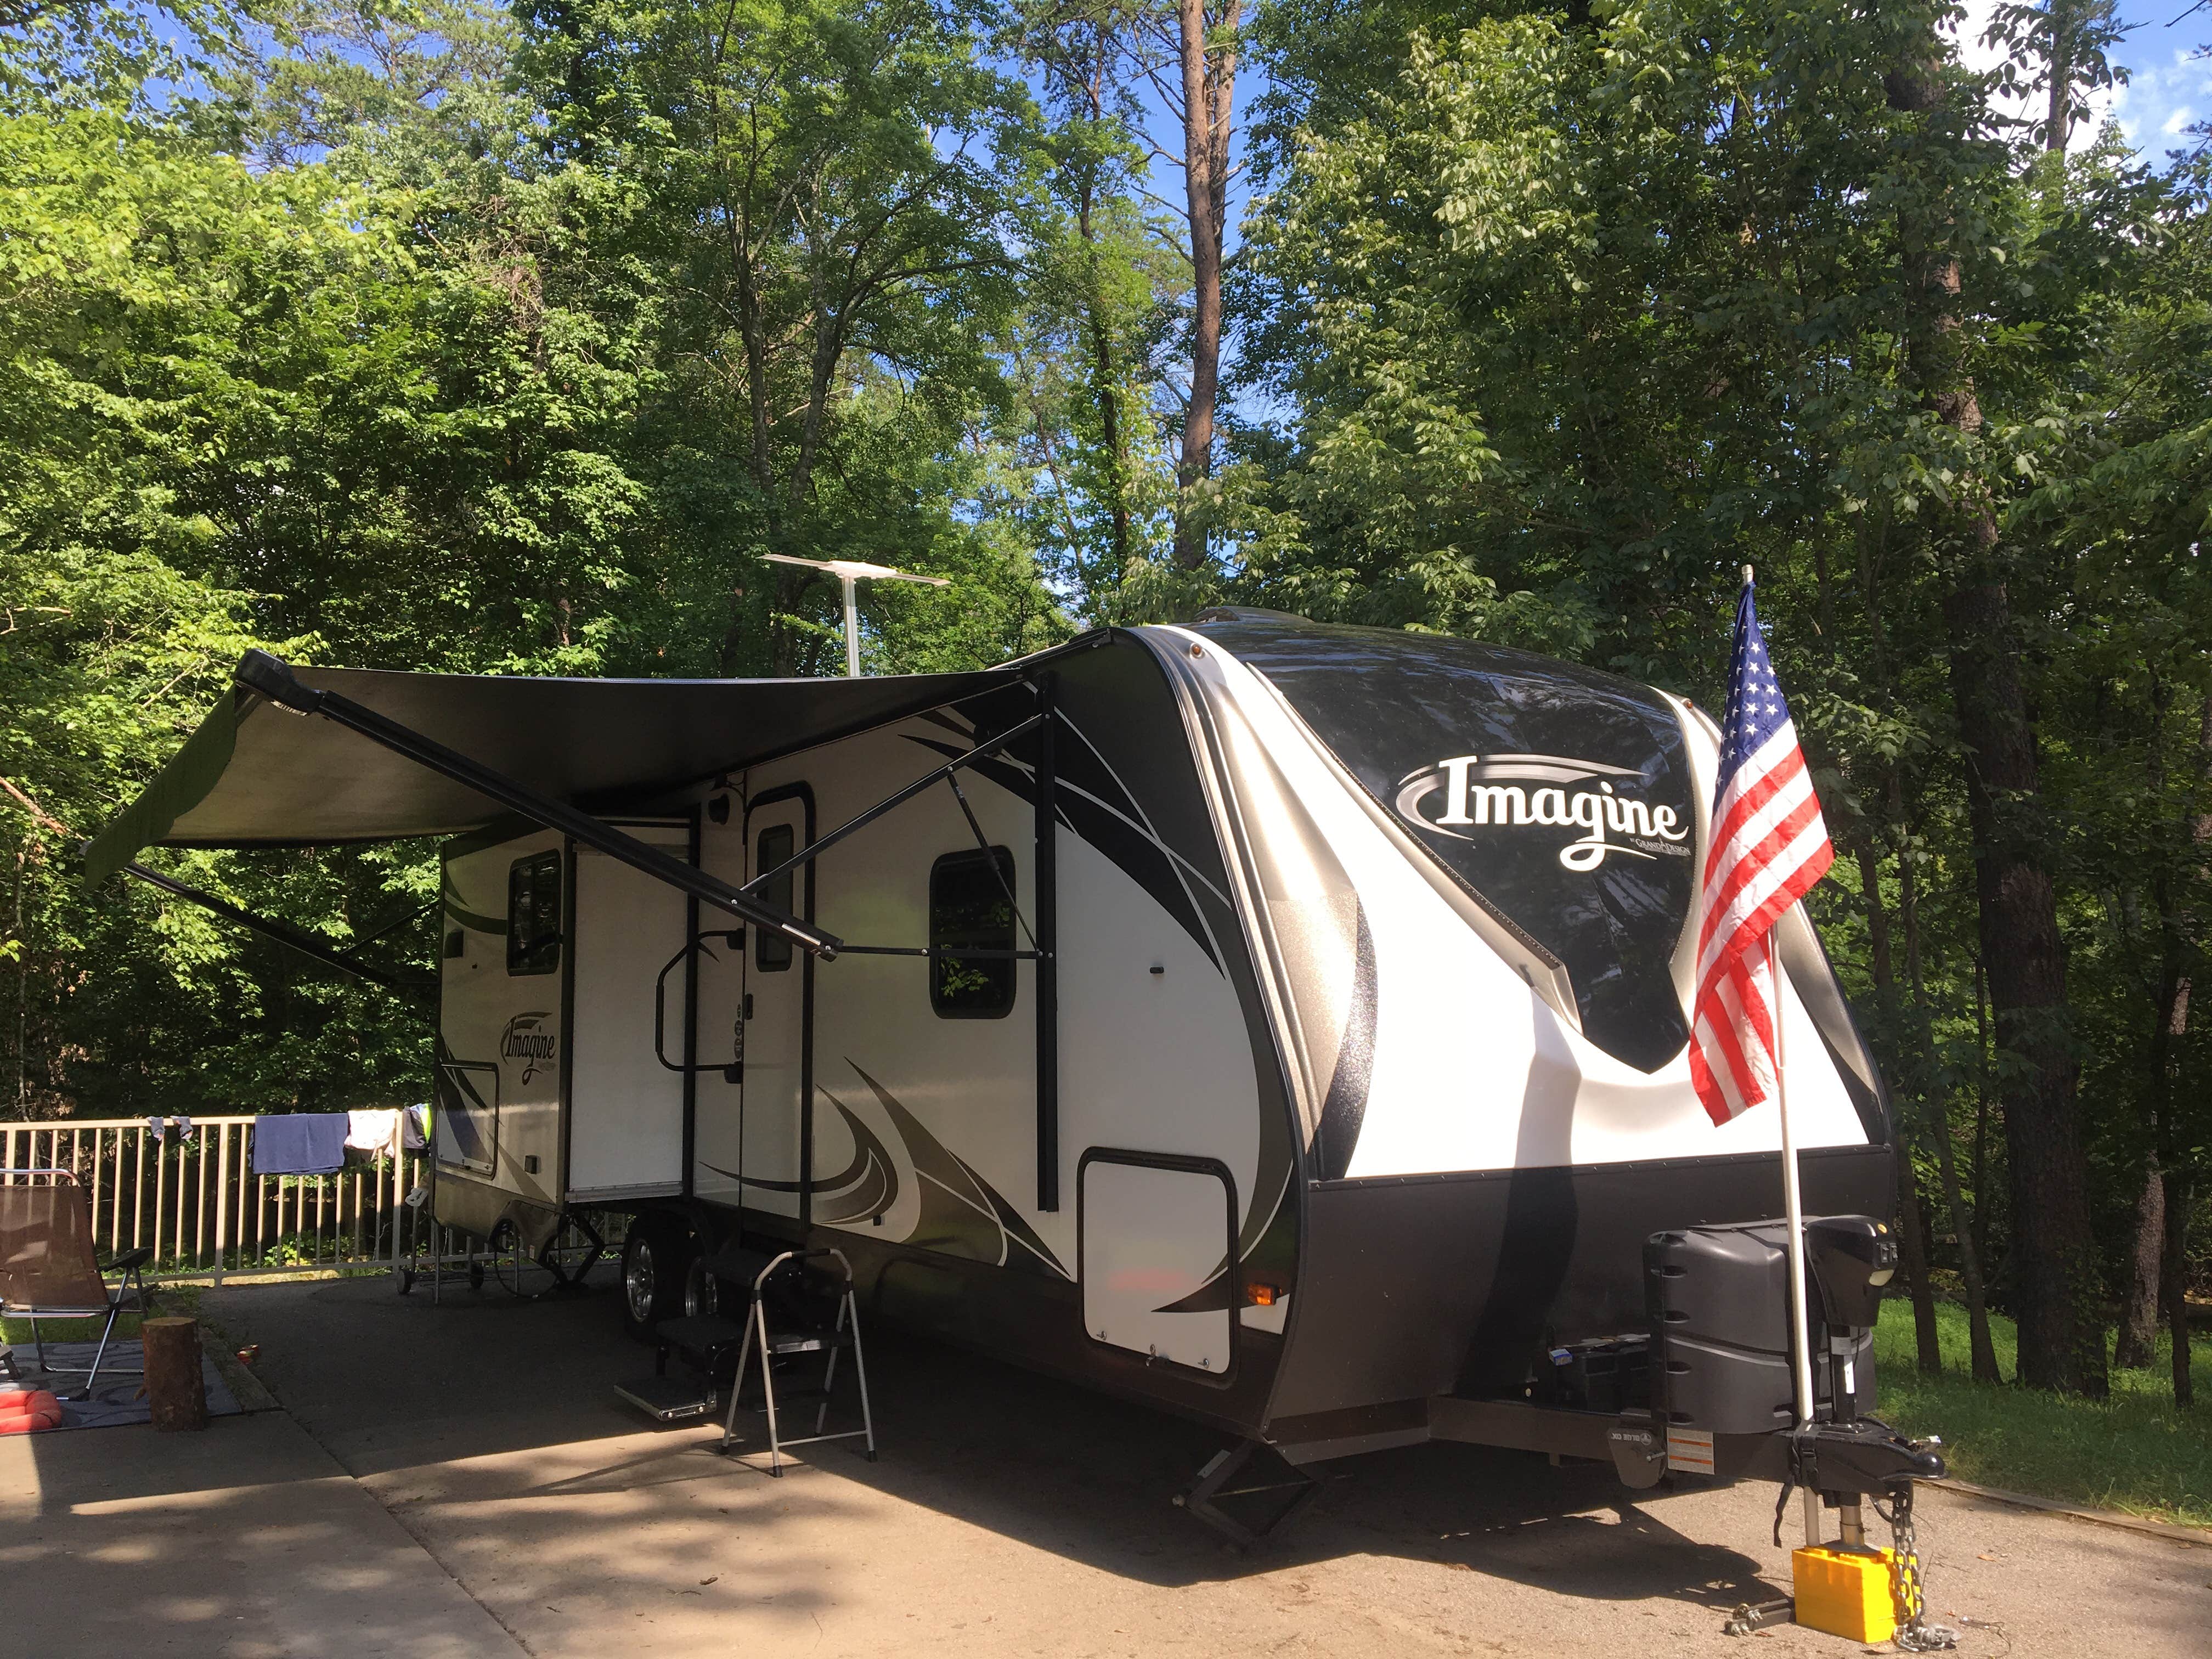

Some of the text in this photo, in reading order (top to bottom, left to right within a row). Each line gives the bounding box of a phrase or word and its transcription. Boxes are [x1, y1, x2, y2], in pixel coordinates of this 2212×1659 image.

[1436, 755, 1689, 871] Imagine
[1635, 838, 1661, 849] GRAND
[1666, 843, 1691, 854] DESIGN
[505, 1015, 556, 1085] Imagine
[1622, 1433, 1640, 1441] BLUE
